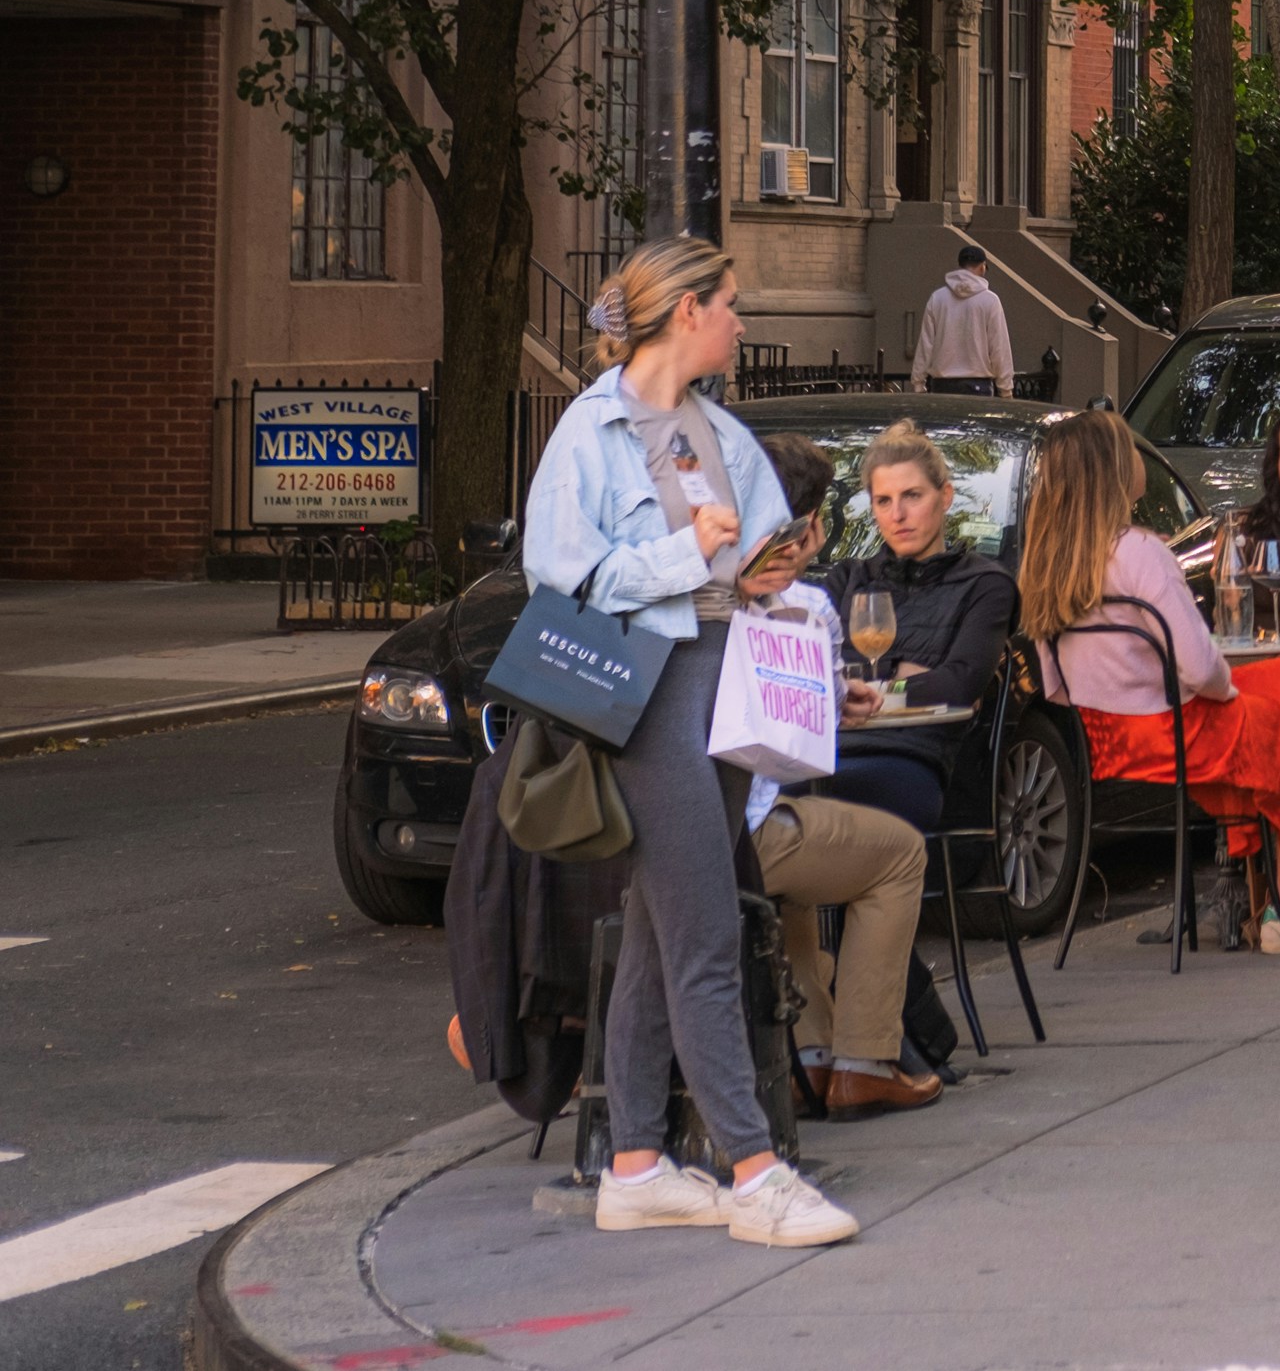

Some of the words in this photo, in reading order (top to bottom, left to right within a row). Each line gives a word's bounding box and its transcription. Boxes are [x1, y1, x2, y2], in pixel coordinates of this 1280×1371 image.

[258, 402, 314, 423] WEST
[323, 401, 413, 424] VILLAGE
[258, 428, 354, 462] MEN'S
[359, 429, 414, 462] SPA
[263, 496, 323, 507] 11AM-11PM
[331, 496, 337, 507] 7
[339, 496, 368, 507] DAYS
[370, 496, 377, 507] A
[379, 496, 409, 507] WEEK
[308, 509, 335, 520] PERRY
[337, 509, 369, 520] STREET
[538, 629, 599, 666] RESCUE
[602, 658, 632, 682] SPA
[746, 626, 826, 681] CONTAIN
[756, 678, 828, 737] YOURSELF
